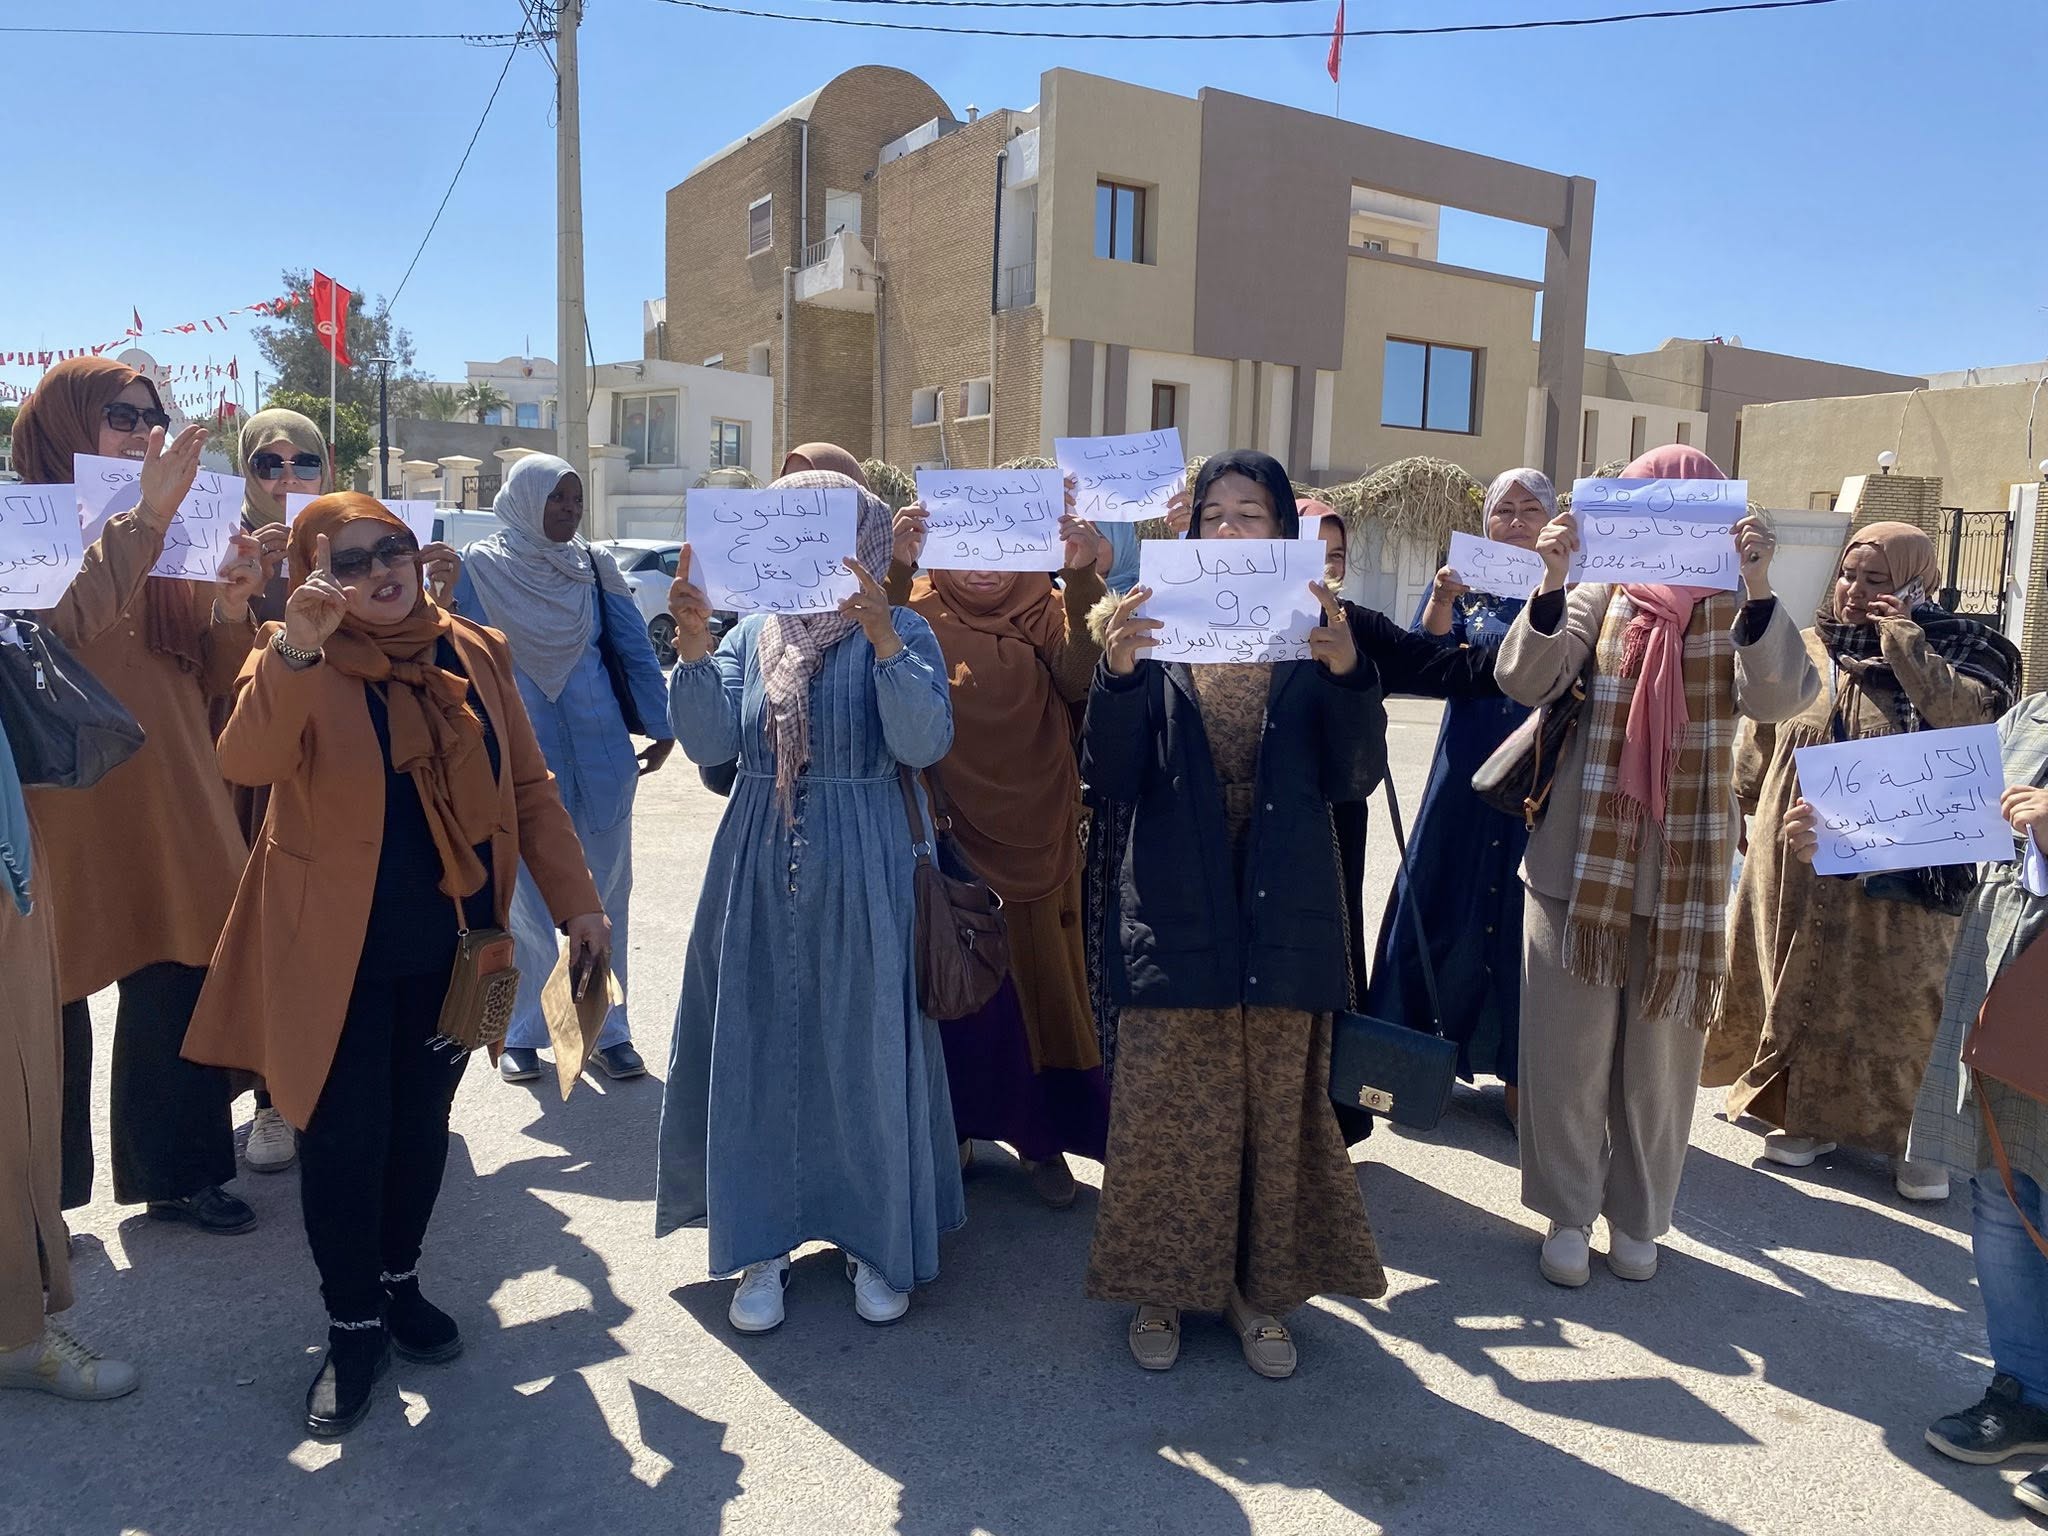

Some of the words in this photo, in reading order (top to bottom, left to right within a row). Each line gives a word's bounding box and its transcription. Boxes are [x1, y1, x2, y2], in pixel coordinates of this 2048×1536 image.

[932, 481, 959, 505] في
[1085, 491, 1119, 513] 16
[1589, 486, 1631, 504] 90
[1647, 483, 1728, 512] الفصل
[713, 489, 829, 530] القانون
[1595, 517, 1684, 540] قانون
[1690, 524, 1730, 538] من
[727, 528, 830, 564] مشروع
[954, 541, 980, 557] 90
[981, 531, 1053, 561] الفصل
[1160, 542, 1287, 585] الفصل
[1576, 554, 1625, 569] 2026
[1630, 552, 1729, 580] الميزانية
[724, 588, 834, 612] القانون
[1208, 590, 1271, 626] 90
[1820, 760, 1862, 798] 16
[1877, 744, 1990, 794] الآلية
[1824, 794, 1933, 838] المباشرين
[1921, 786, 1987, 827] الغير
